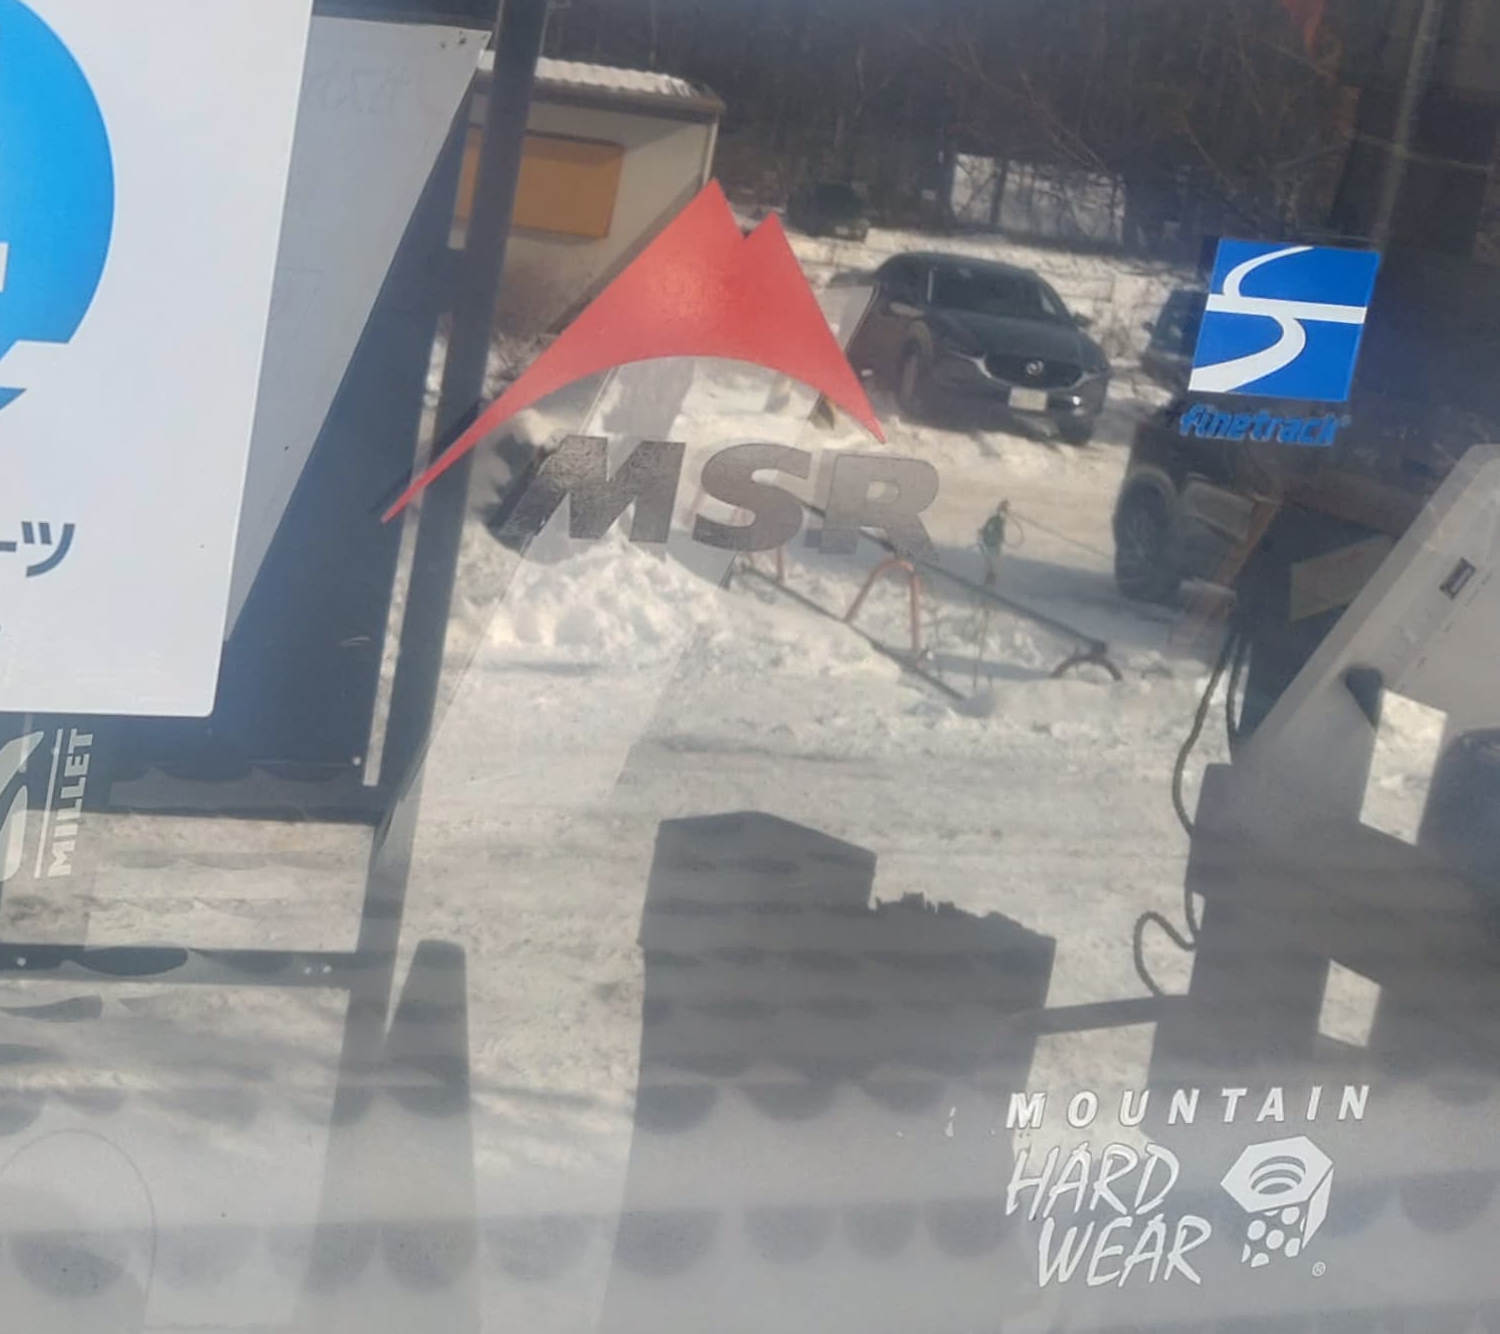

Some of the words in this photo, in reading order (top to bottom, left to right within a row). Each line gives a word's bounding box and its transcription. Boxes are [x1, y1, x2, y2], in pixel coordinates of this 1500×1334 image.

[1179, 402, 1339, 448] finetrack
[498, 433, 941, 563] MSR
[47, 728, 94, 878] MILLET
[1005, 1084, 1370, 1130] MOUNTAIN
[1005, 1141, 1181, 1220] HARD
[1037, 1213, 1213, 1288] WEAR
